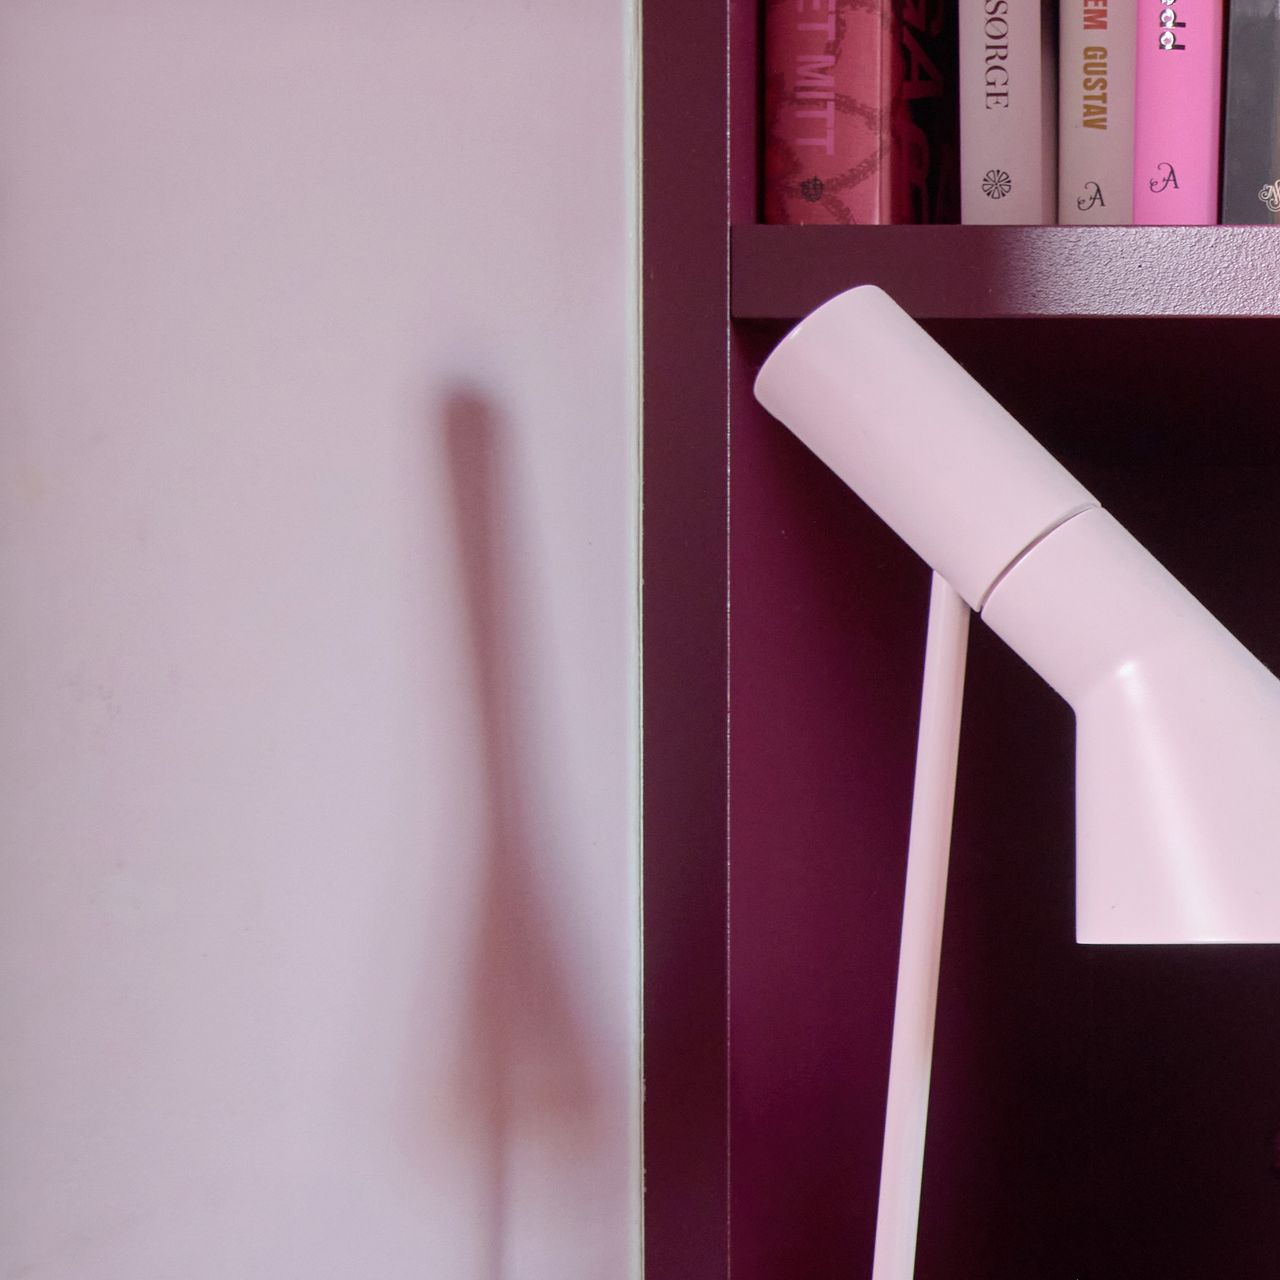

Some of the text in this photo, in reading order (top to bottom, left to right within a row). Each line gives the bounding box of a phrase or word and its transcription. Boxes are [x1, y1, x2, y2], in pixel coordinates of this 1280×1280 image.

[1159, 0, 1186, 50] dd
[796, 54, 835, 155] MITT
[1083, 46, 1108, 130] GUSTAV
